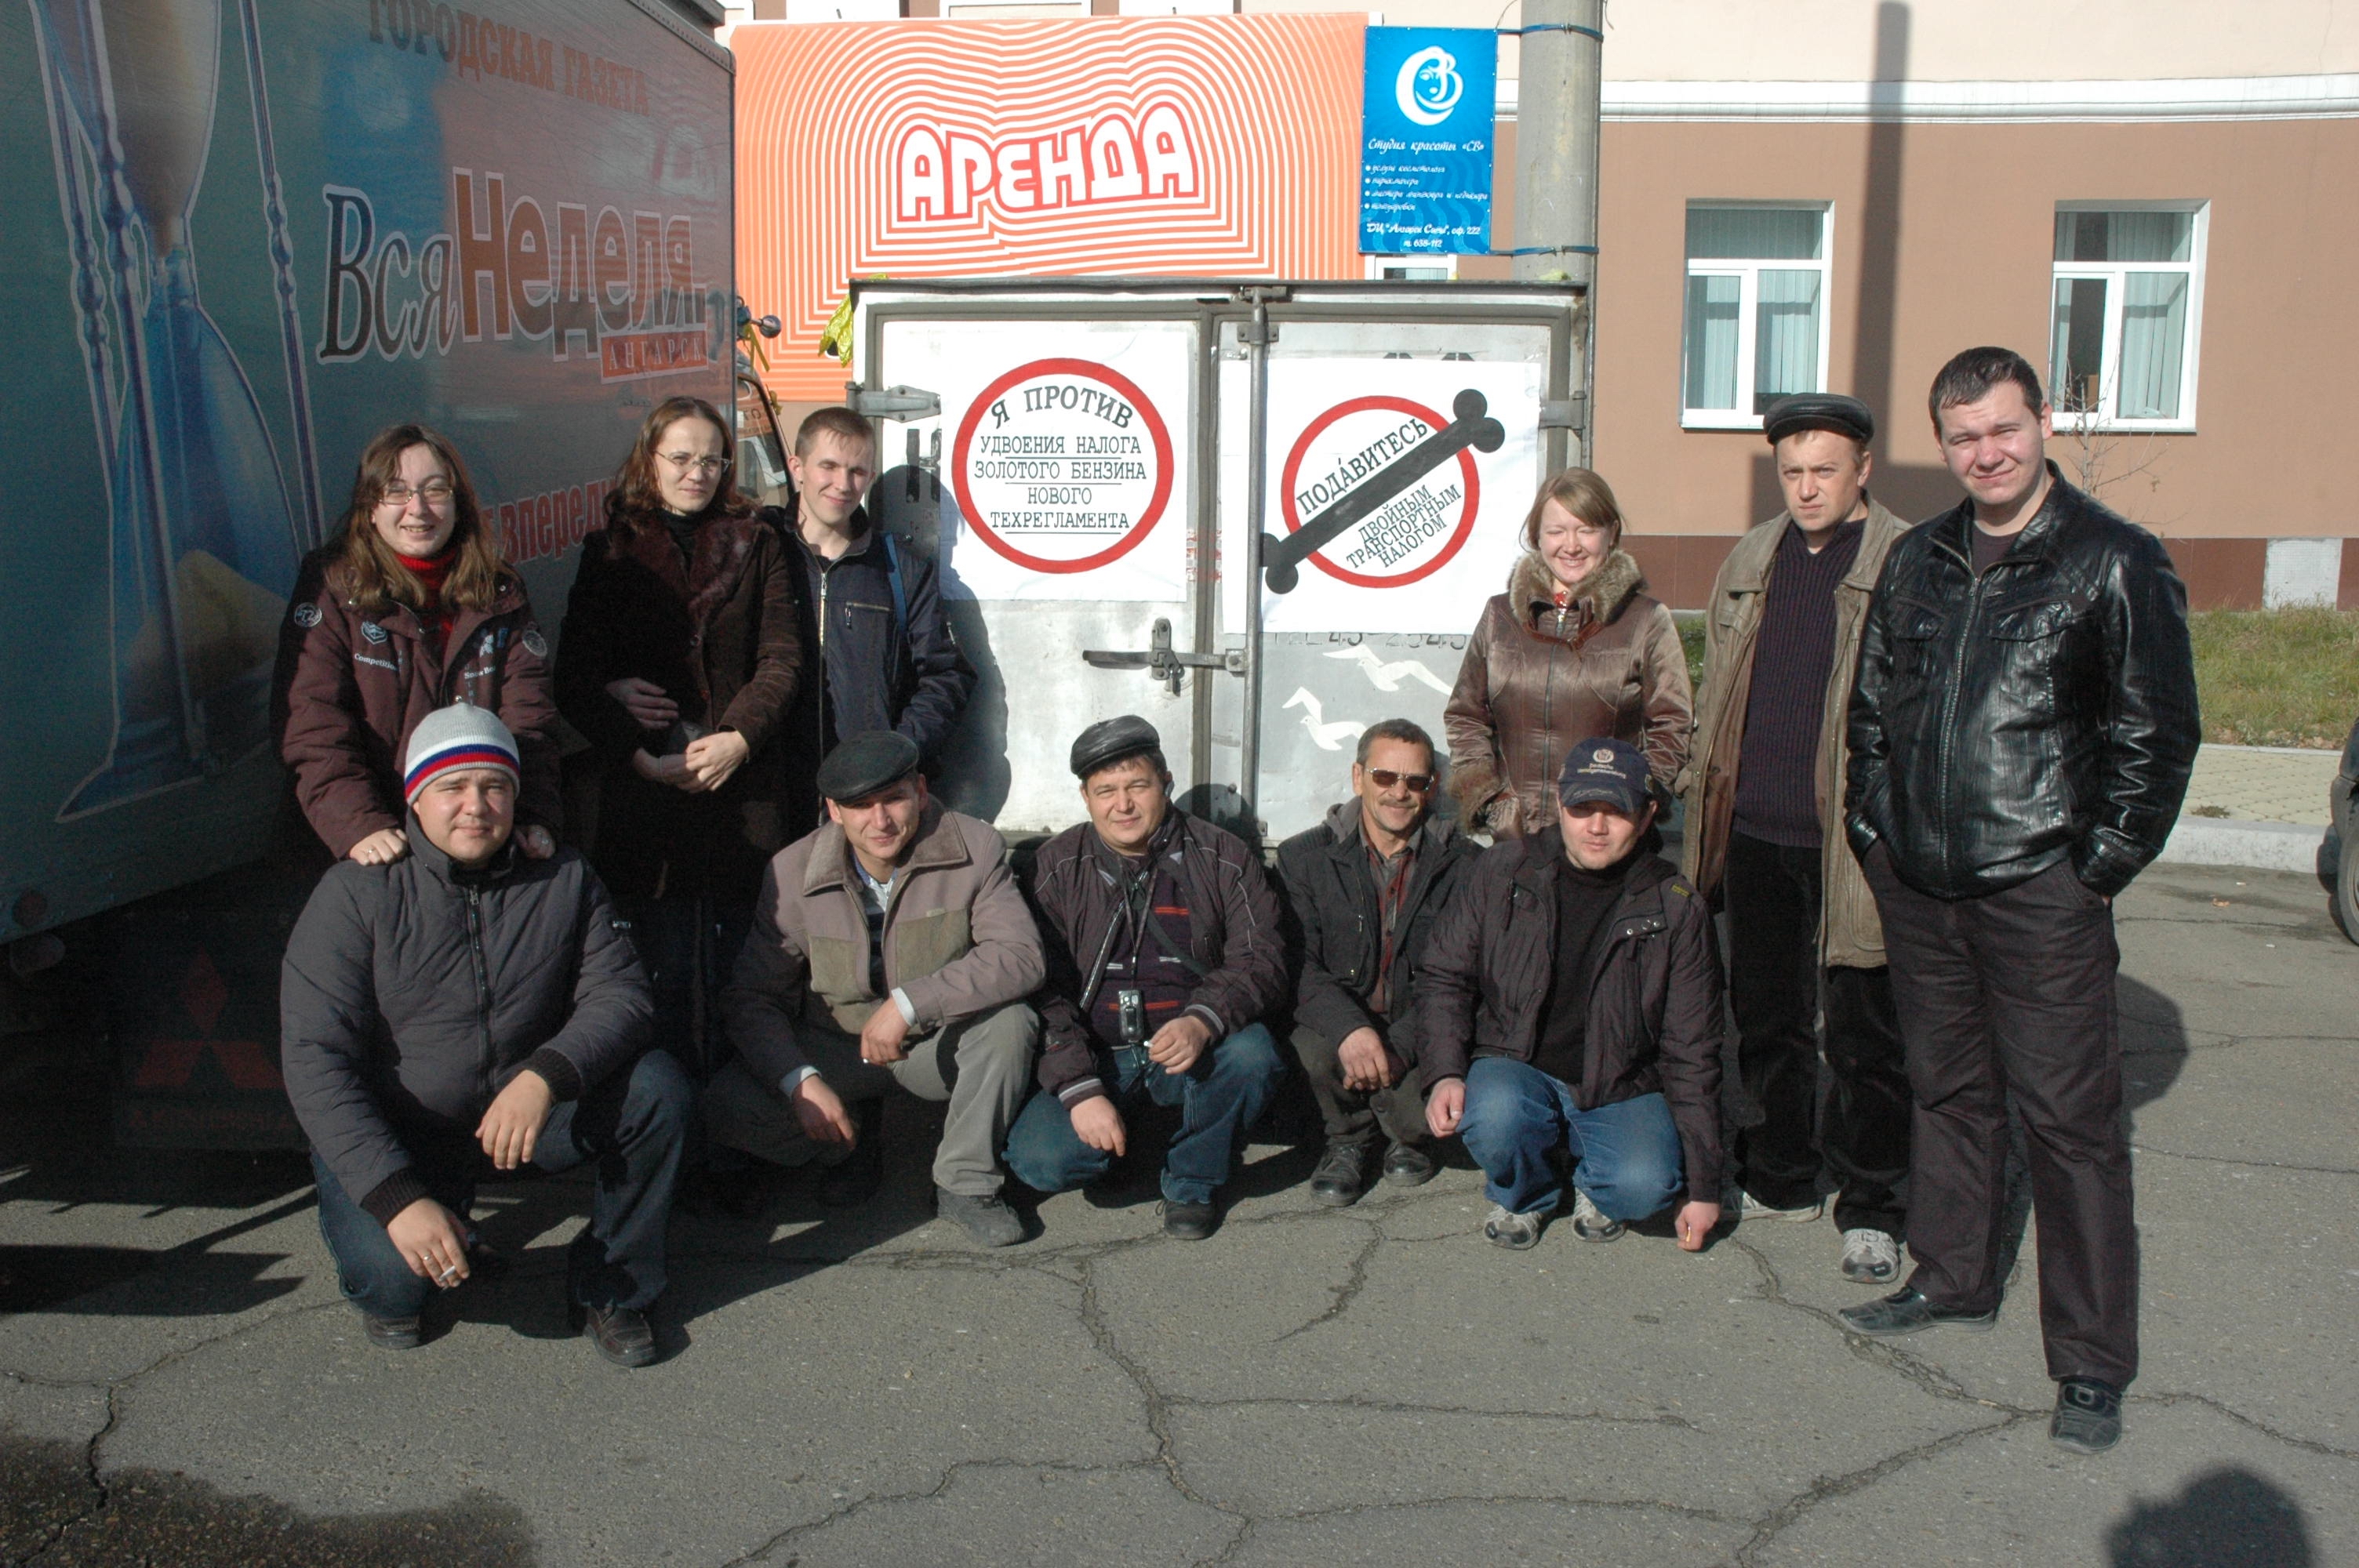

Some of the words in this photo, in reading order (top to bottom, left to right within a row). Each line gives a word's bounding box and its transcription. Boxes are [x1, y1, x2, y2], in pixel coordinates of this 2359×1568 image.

[563, 44, 649, 118] ГАЗЕТА
[897, 101, 1199, 222] АРЕНДА
[1368, 138, 1405, 155] Студия
[1410, 141, 1456, 155] красоты
[609, 337, 702, 371] АНГАРСК
[990, 399, 1010, 429] Я
[1023, 386, 1133, 429] ПРОТИВ
[980, 436, 1065, 456] УДВОЕНИЯ
[1076, 436, 1141, 454] НАЛОГА
[974, 461, 1060, 479] ЗОЛОТОГО
[1071, 462, 1147, 480] БЕНЗИНА
[1027, 487, 1092, 505] НОВОГО
[1358, 485, 1433, 543] ДВОЙНЫМ
[990, 511, 1129, 529] ТЕХРЕГЛАМЕНТА
[1346, 484, 1462, 569] ТРАНСПОРТНЫМ
[1377, 514, 1447, 568] НАЛОГОМ
